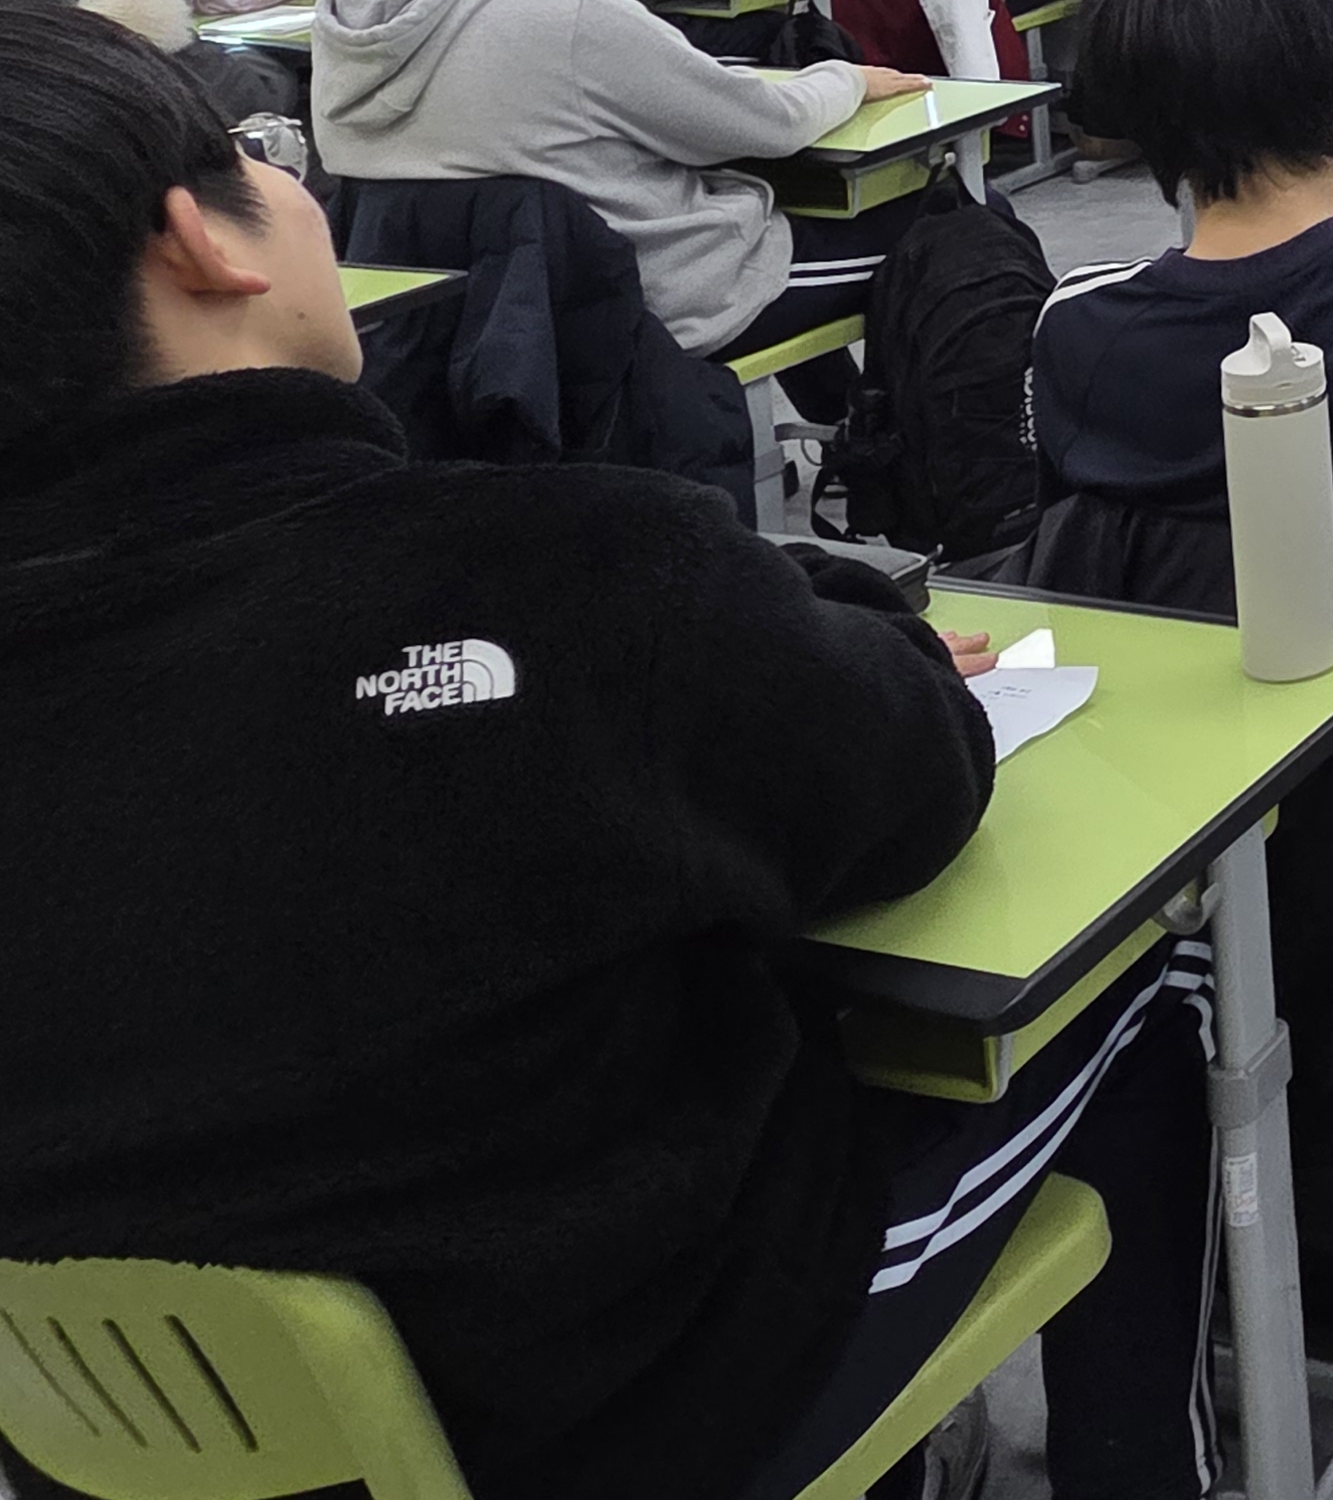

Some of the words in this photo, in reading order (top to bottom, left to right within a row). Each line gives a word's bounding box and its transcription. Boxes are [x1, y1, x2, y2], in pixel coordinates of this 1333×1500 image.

[402, 641, 463, 668] THE
[355, 662, 462, 700] NORTH
[384, 682, 462, 717] FACE
